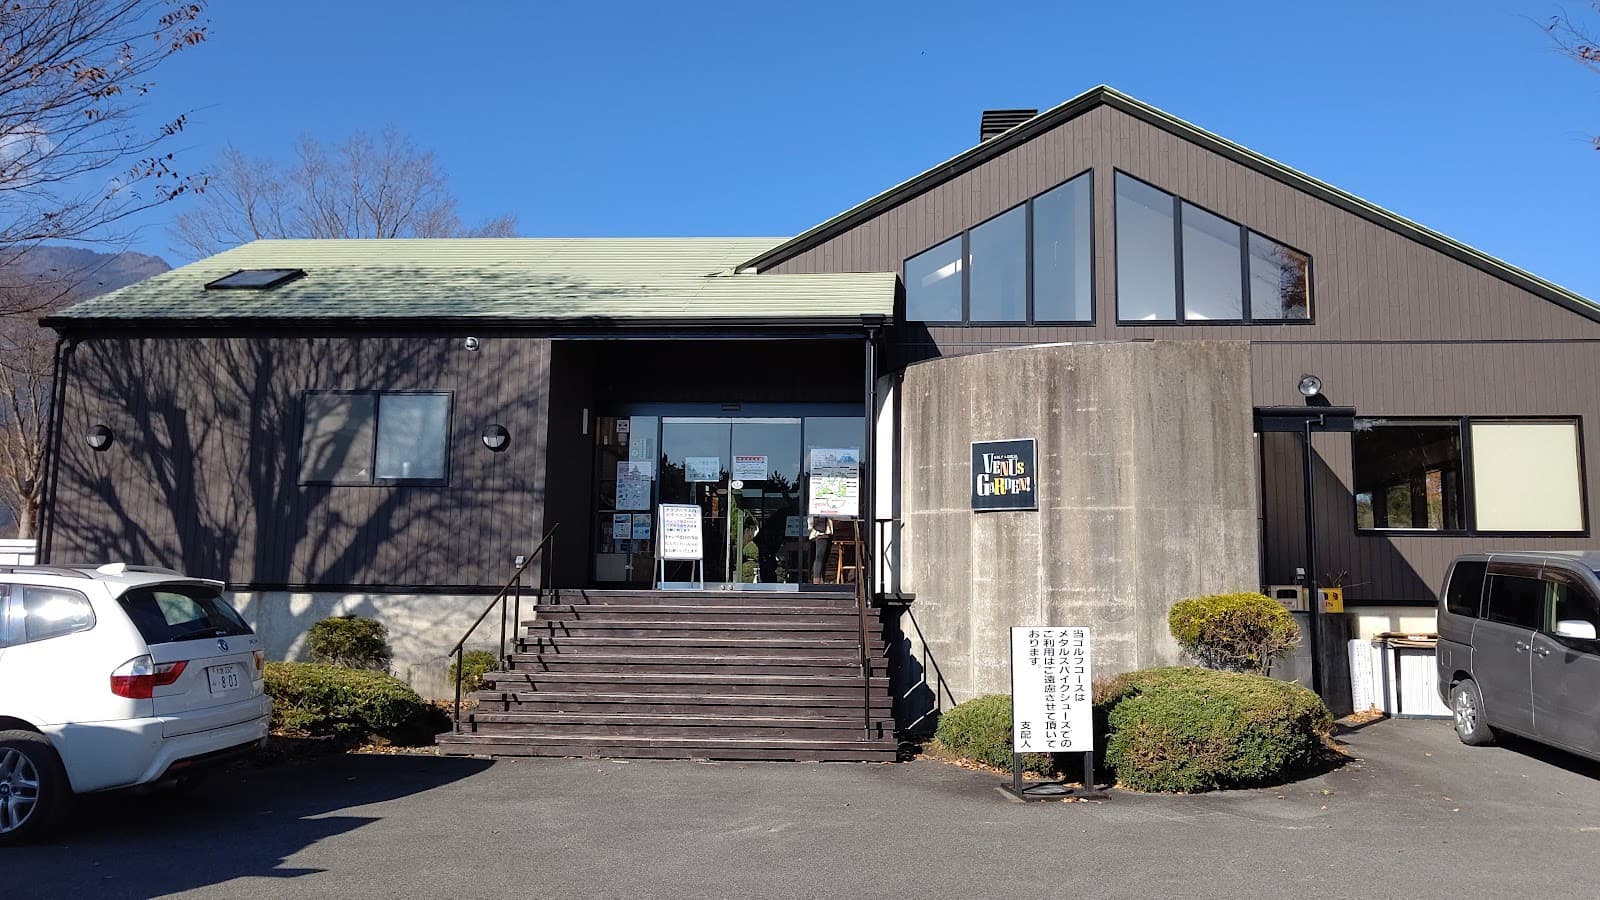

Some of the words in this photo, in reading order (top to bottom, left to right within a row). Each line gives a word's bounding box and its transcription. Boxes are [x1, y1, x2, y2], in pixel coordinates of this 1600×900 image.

[1073, 629, 1085, 702] 当ゴルフコースは
[1020, 721, 1032, 748] 支配人
